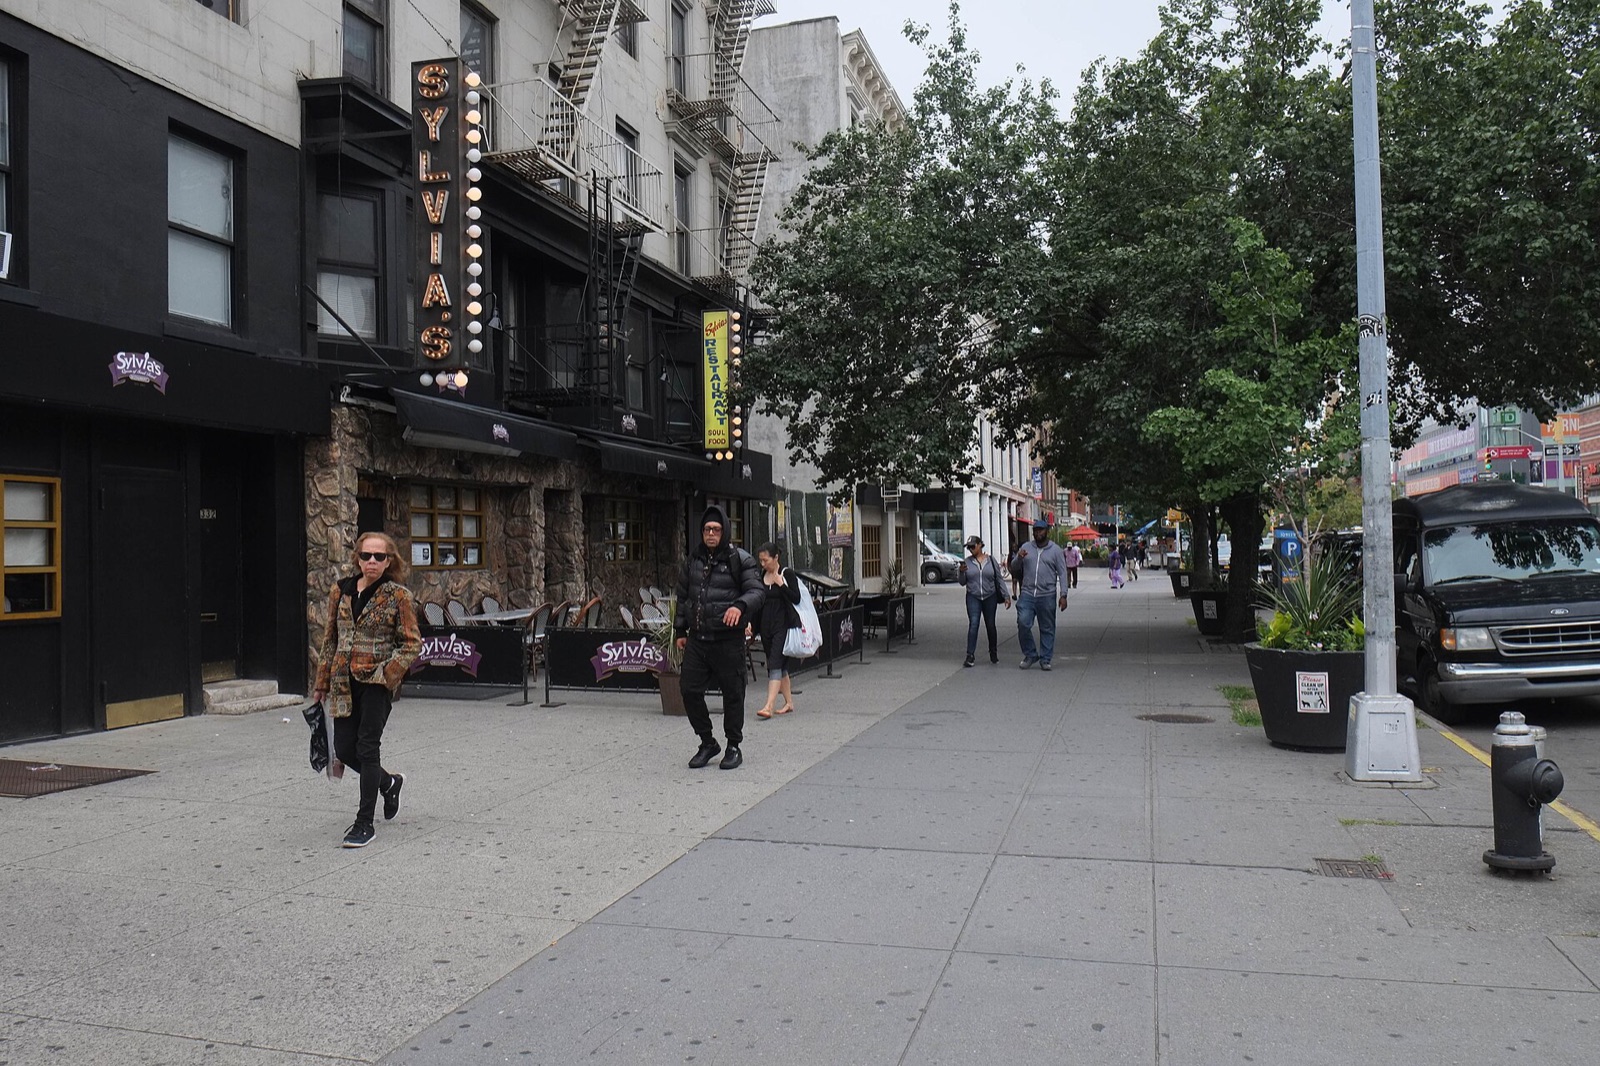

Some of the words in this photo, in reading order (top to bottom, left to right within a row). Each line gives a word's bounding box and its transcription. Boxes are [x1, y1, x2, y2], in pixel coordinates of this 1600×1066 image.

[417, 64, 452, 359] SYLVIA'S
[116, 351, 161, 376] Sylvia's
[705, 338, 727, 426] RESTAURANT
[709, 438, 726, 446] FOOD
[1287, 542, 1298, 556] P
[601, 637, 664, 662] Sylvia's
